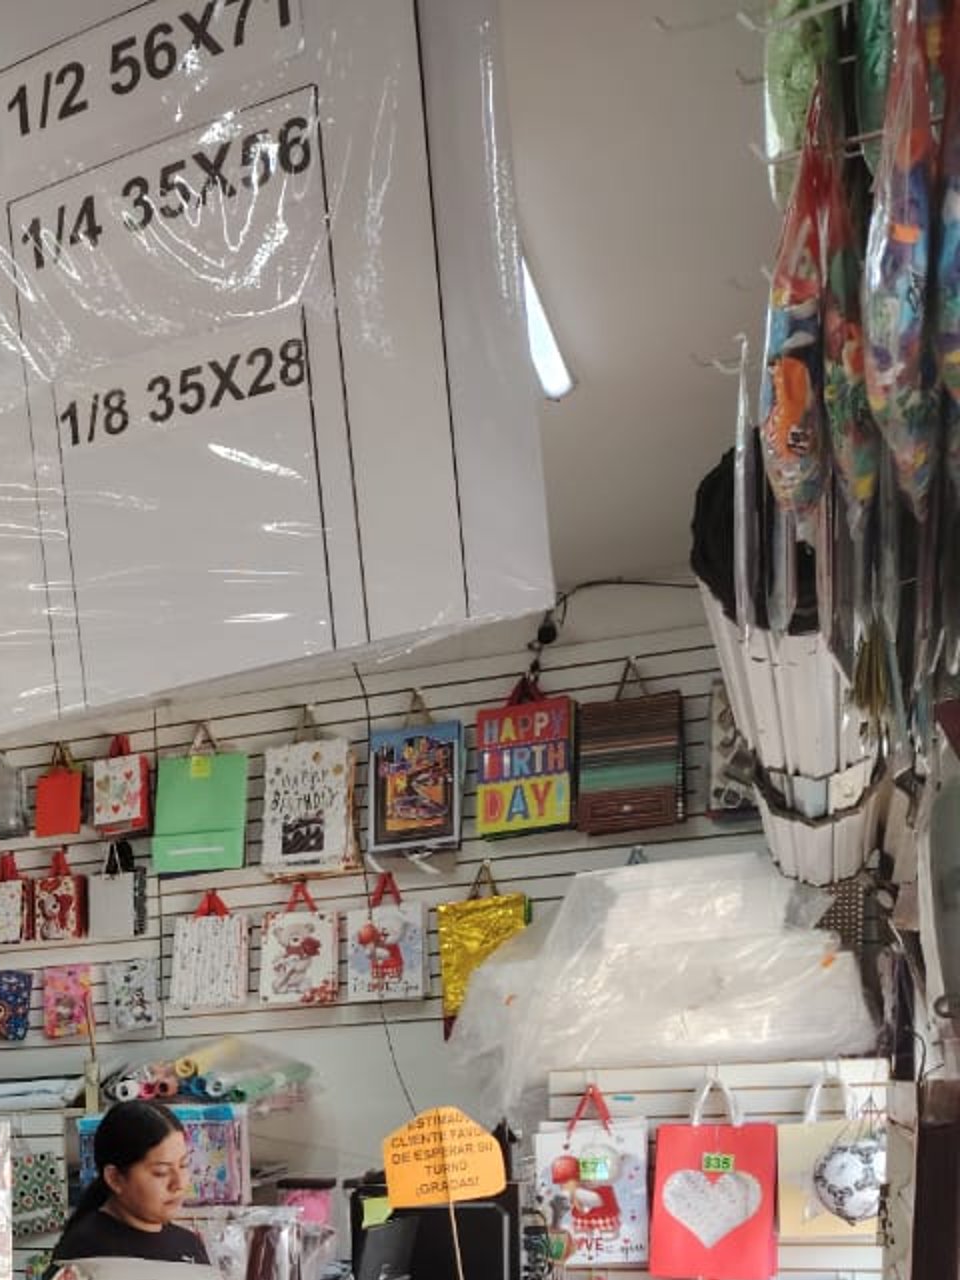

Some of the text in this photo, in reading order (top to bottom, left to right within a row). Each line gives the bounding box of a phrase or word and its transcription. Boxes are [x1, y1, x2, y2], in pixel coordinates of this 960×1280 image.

[7, 61, 88, 136] 1/2
[21, 116, 312, 269] 1/4 35X56
[60, 338, 306, 446] 1/8 35X28
[483, 708, 564, 746] HAPPY
[483, 741, 565, 781] BIRTH
[483, 779, 565, 823] DAY!
